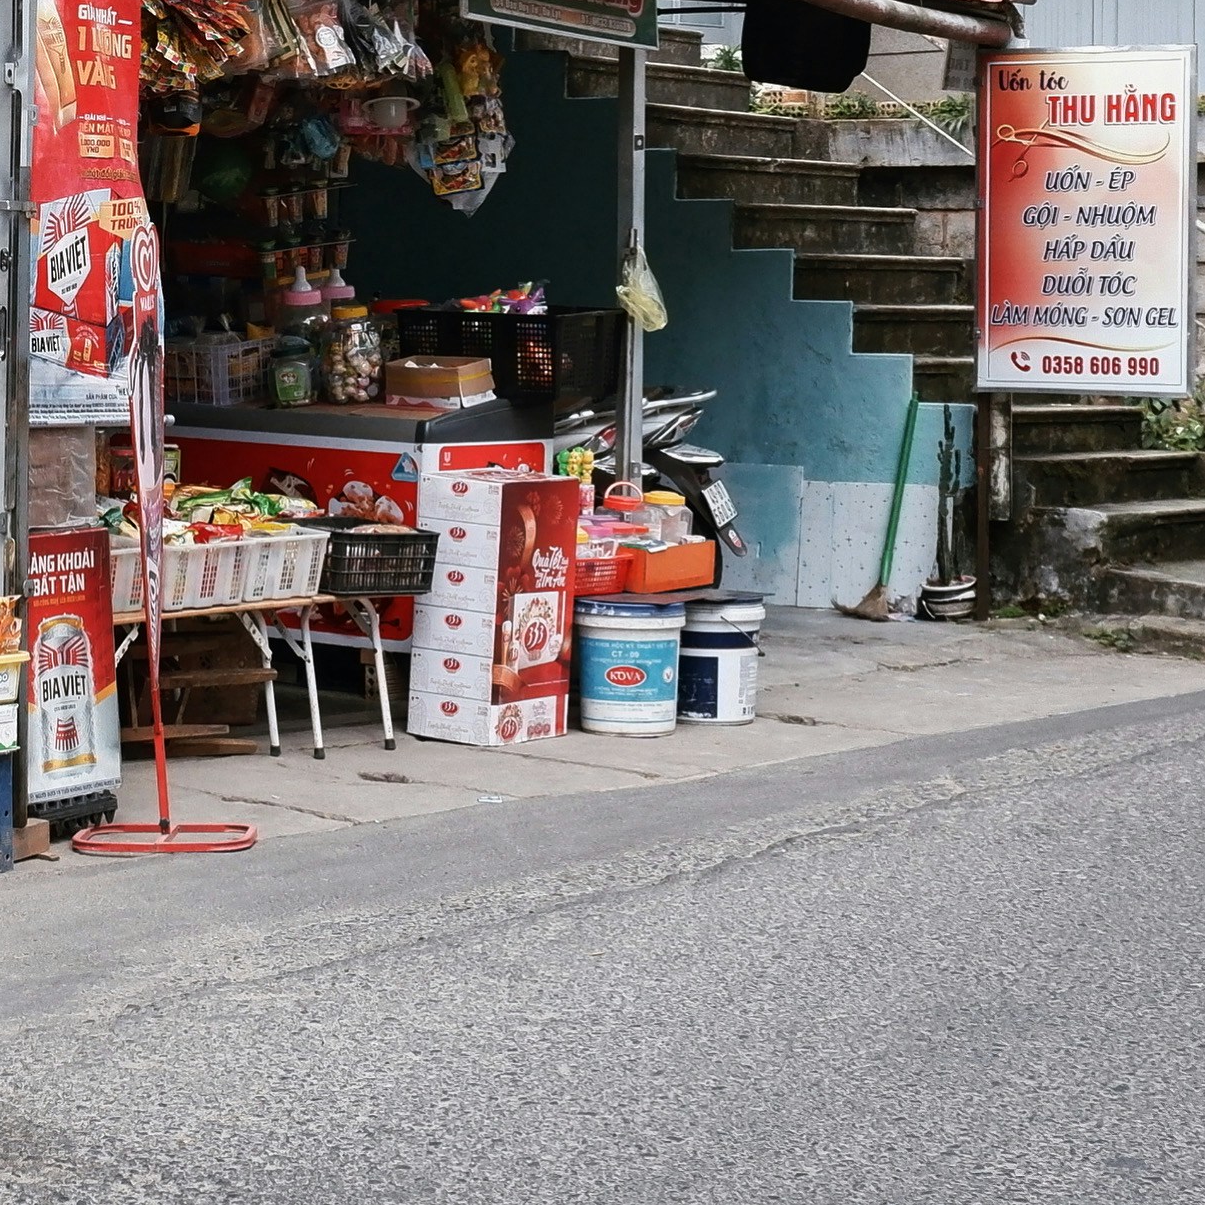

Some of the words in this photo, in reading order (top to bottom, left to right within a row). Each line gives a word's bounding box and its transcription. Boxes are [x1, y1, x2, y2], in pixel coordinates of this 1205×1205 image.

[77, 26, 86, 51] 1
[998, 69, 1032, 92] Uốn
[1039, 69, 1069, 91] tóc
[1045, 95, 1096, 125] THU
[1104, 83, 1177, 125] HẰNG
[1045, 163, 1091, 192] UỐN
[1108, 165, 1136, 192] ÉP
[1022, 201, 1059, 228] GỘI
[1075, 201, 1156, 229] NHUỘM
[50, 251, 66, 284] BIA
[65, 235, 86, 275] VIỆT
[1043, 233, 1085, 261] HẤP
[1089, 233, 1135, 261] DẦU
[1042, 267, 1093, 296] DUỖI
[1098, 271, 1137, 296] TÓC
[990, 303, 1030, 326] LÀM
[1032, 302, 1087, 326] MÓNG
[1102, 303, 1142, 327] SƠN
[1144, 306, 1178, 327] GEL
[31, 337, 46, 353] BIA
[45, 333, 60, 354] VIỆT
[1041, 354, 1084, 375] 0358
[1089, 354, 1123, 375] 606
[1127, 354, 1160, 376] 990
[57, 547, 94, 572] KHOÁI
[33, 572, 56, 597] BẤT
[59, 571, 85, 595] TẬN
[611, 650, 622, 658] CT
[42, 677, 61, 702] BIA
[62, 671, 86, 699] VIỆT
[609, 671, 641, 681] KOVA
